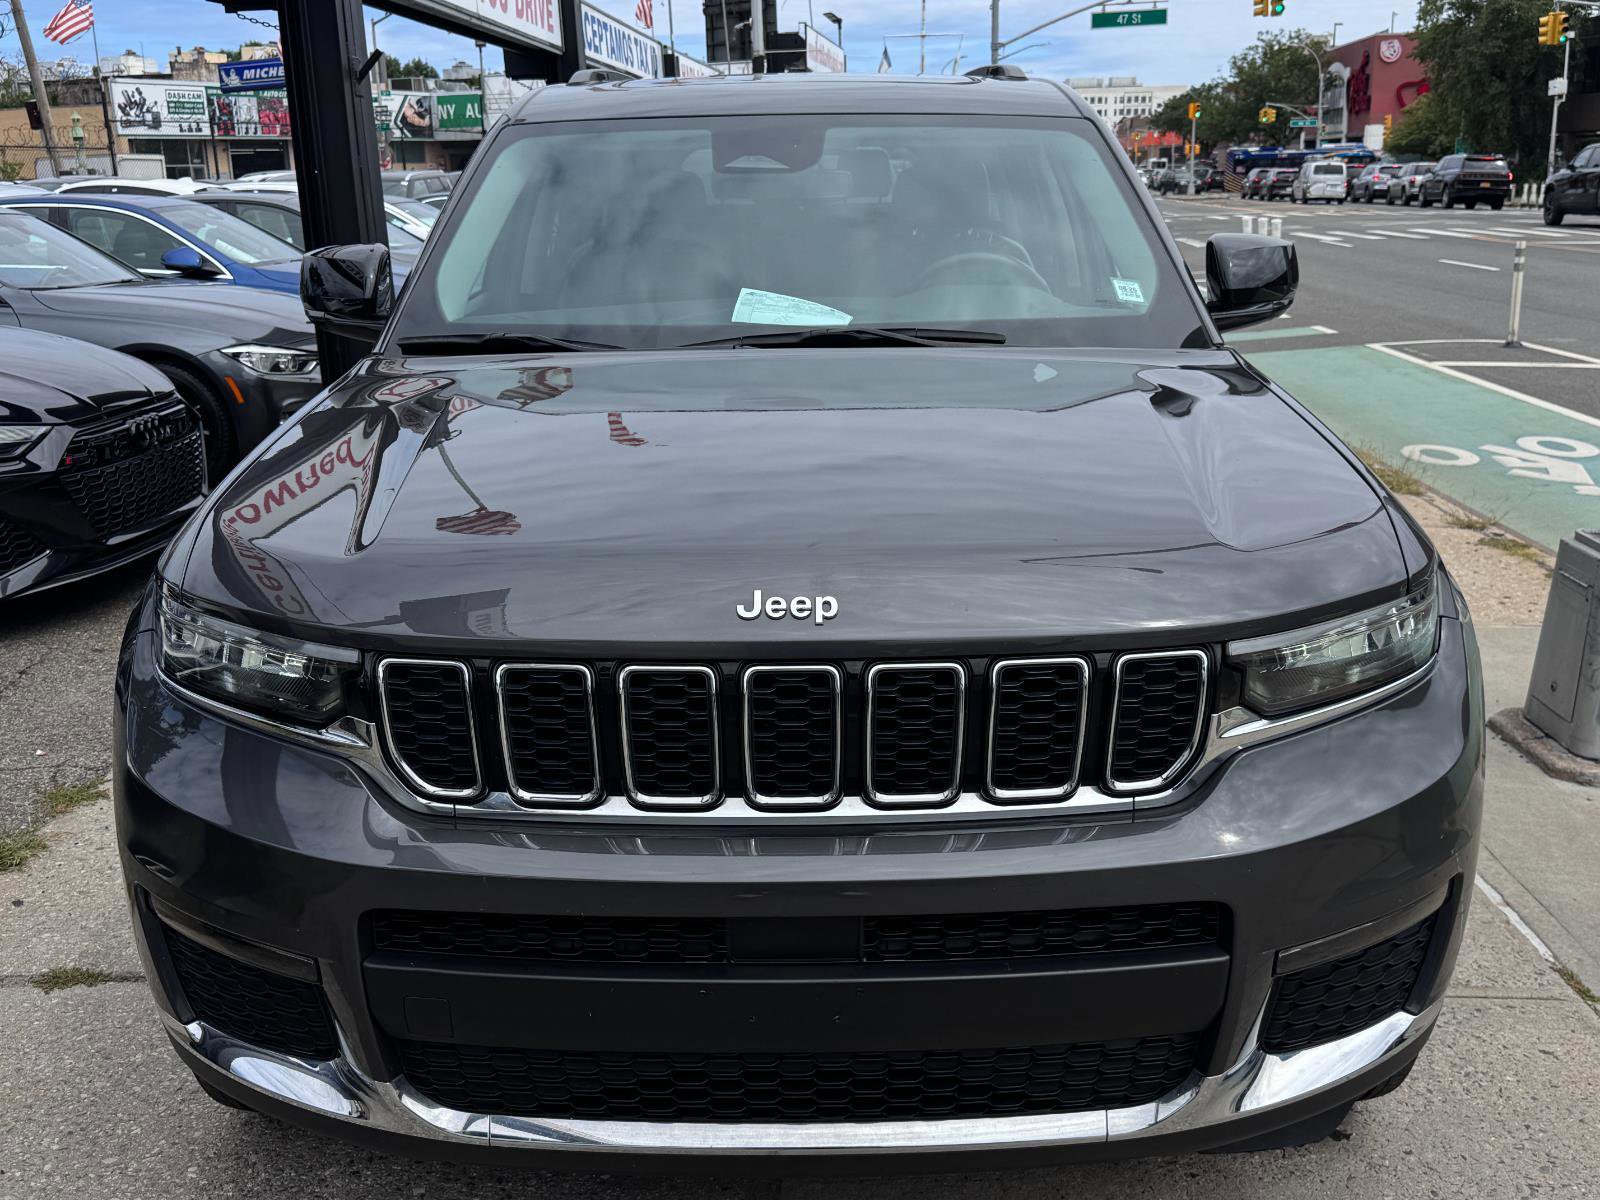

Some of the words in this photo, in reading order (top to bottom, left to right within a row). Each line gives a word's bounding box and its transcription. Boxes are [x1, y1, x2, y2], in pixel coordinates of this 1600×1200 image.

[1116, 14, 1128, 24] 47
[1131, 13, 1141, 24] St
[634, 36, 650, 75] TAX
[167, 92, 186, 100] DASH
[438, 104, 456, 120] NY
[736, 589, 839, 626] Jeep
